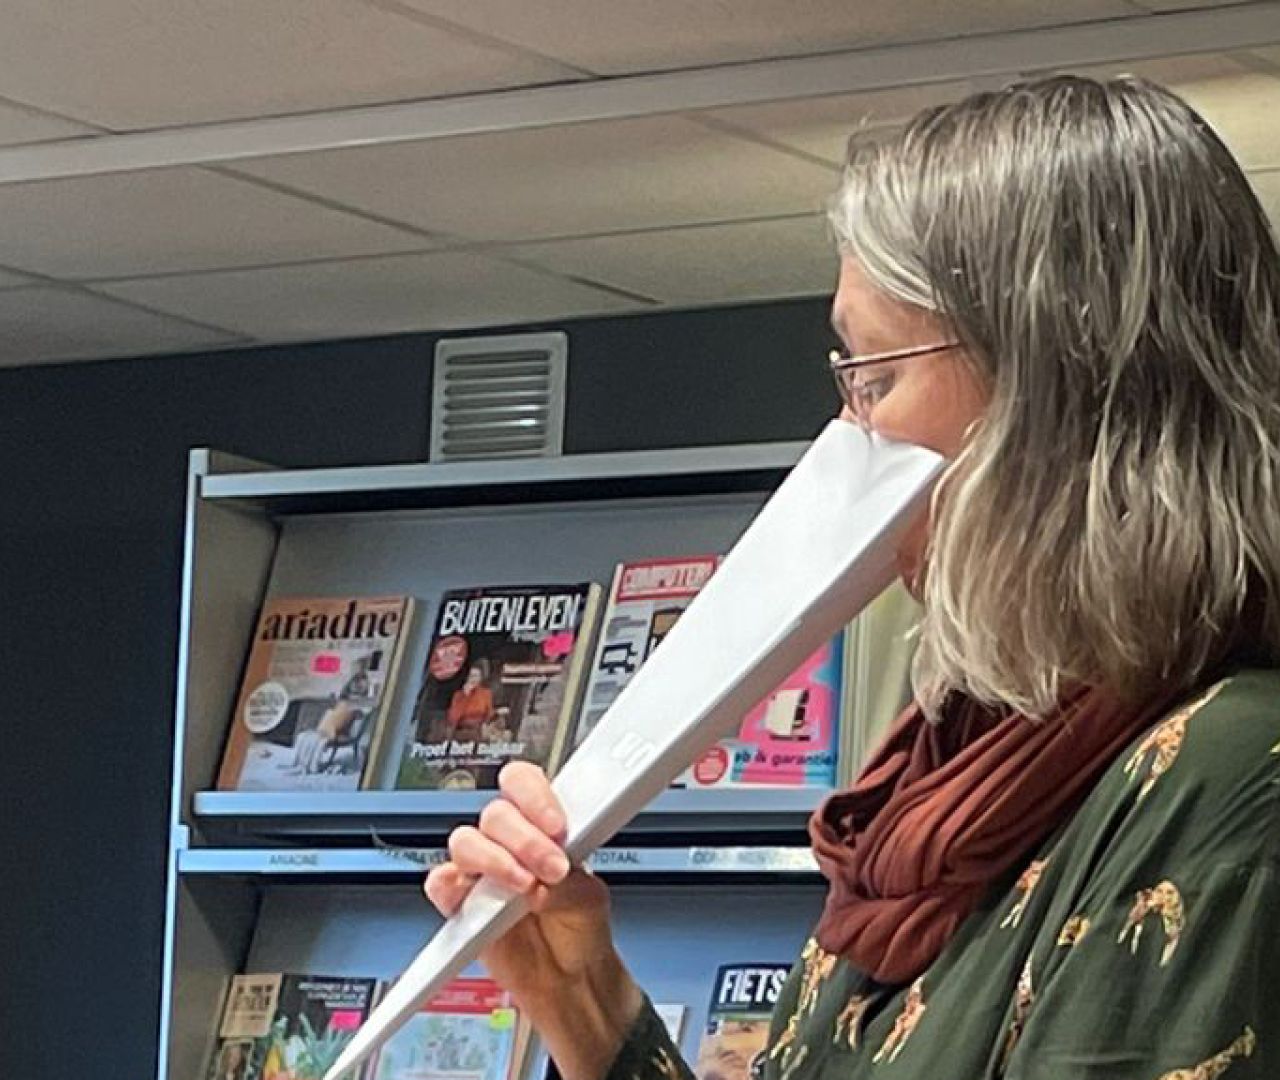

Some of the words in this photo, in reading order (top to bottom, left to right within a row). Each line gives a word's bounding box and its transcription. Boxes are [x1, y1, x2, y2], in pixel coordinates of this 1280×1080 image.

[261, 600, 398, 641] ariadne
[440, 593, 581, 635] BUITENLEVEN
[718, 967, 789, 1004] FIETS
